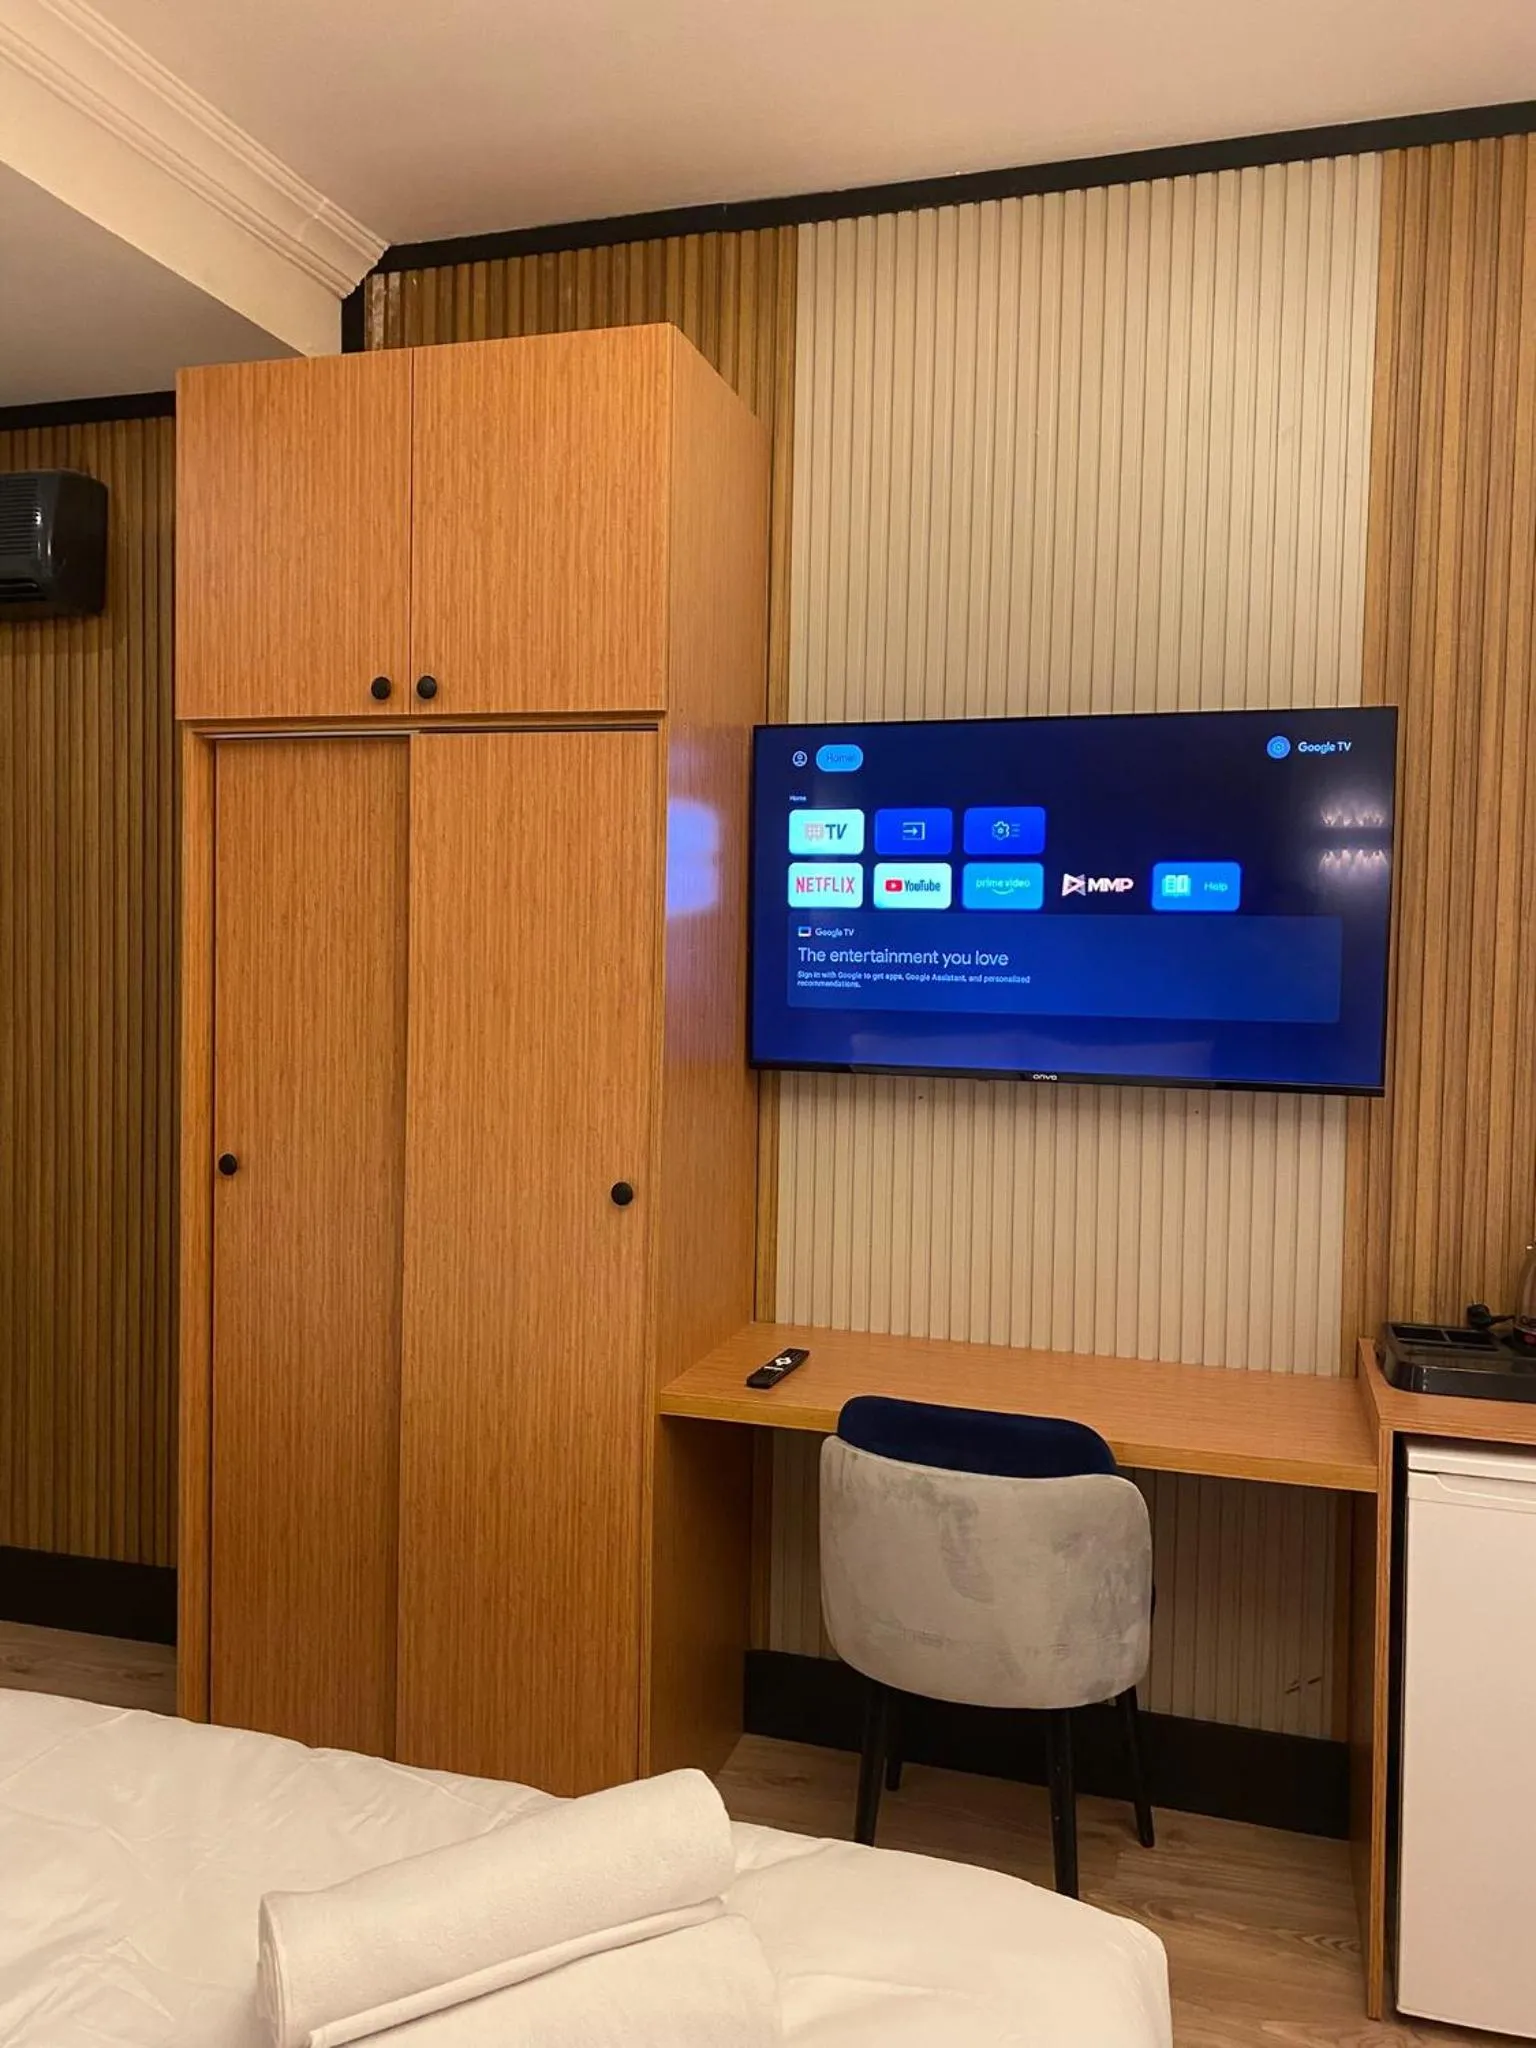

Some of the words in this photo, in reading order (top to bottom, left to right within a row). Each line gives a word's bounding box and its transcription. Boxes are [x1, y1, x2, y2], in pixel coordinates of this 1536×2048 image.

[1297, 741, 1336, 754] Google
[1337, 742, 1352, 752] TV
[825, 823, 848, 840] TV
[796, 876, 855, 894] NETFLIX
[904, 879, 941, 892] YouTube
[976, 879, 1003, 889] prime
[1004, 878, 1031, 888] video
[1087, 877, 1134, 893] MMP
[1203, 881, 1228, 892] Help
[815, 928, 843, 938] Google
[844, 928, 855, 936] TV
[798, 947, 826, 962] The
[829, 948, 939, 965] entertainment
[942, 952, 972, 968] you
[975, 950, 1009, 966] love
[797, 971, 813, 980] Sign
[821, 971, 837, 979] with
[838, 972, 863, 981] Google
[872, 973, 884, 981] get
[905, 973, 931, 982] Google
